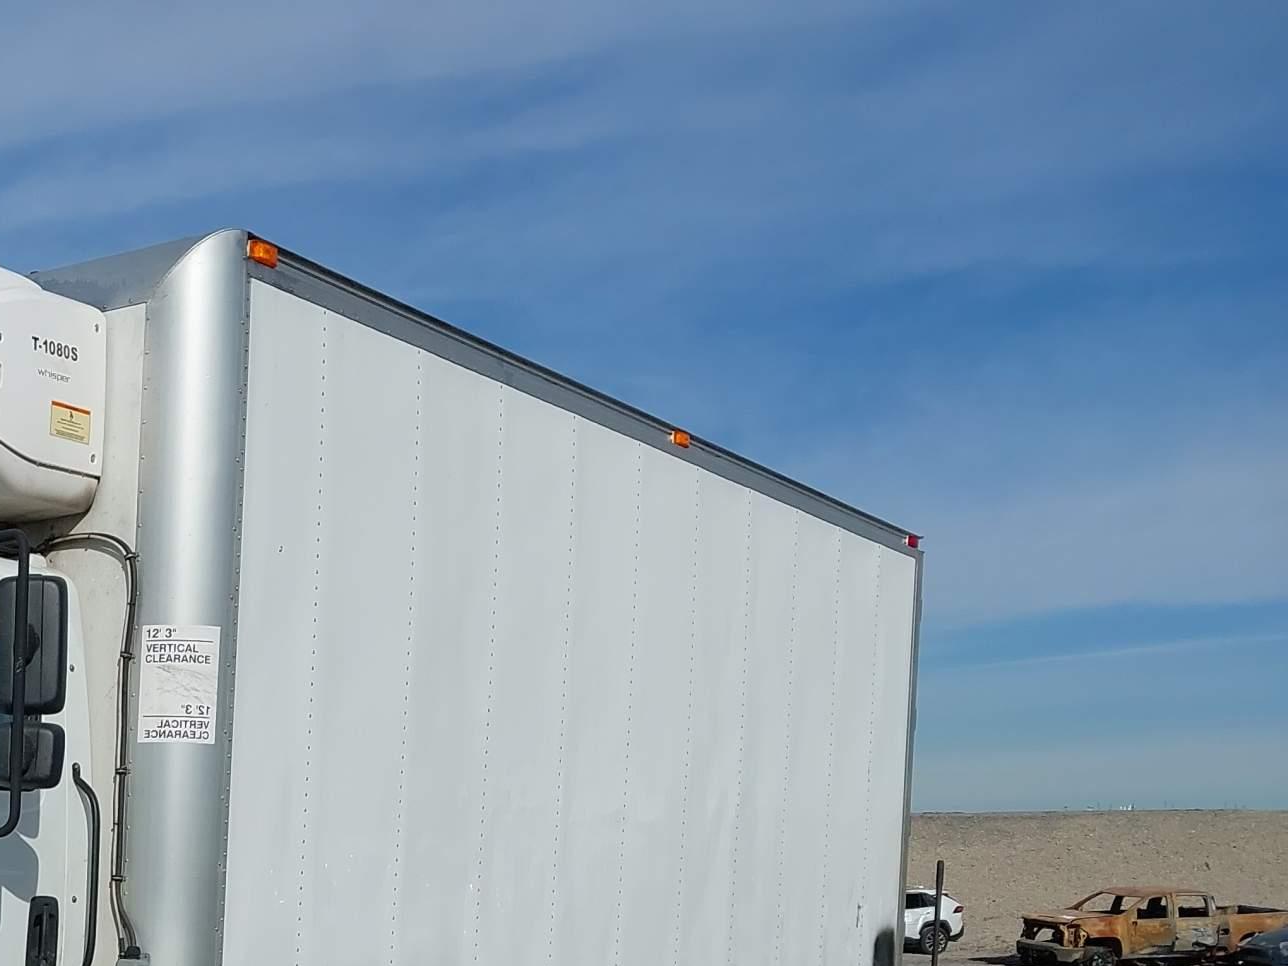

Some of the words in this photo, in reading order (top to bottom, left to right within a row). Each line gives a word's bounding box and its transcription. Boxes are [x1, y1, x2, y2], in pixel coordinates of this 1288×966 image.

[31, 335, 79, 361] T-1080S
[146, 627, 162, 639] 12'
[165, 627, 177, 639] 3"
[146, 643, 199, 653] VERTICAL
[145, 653, 212, 664] CLEARANCE
